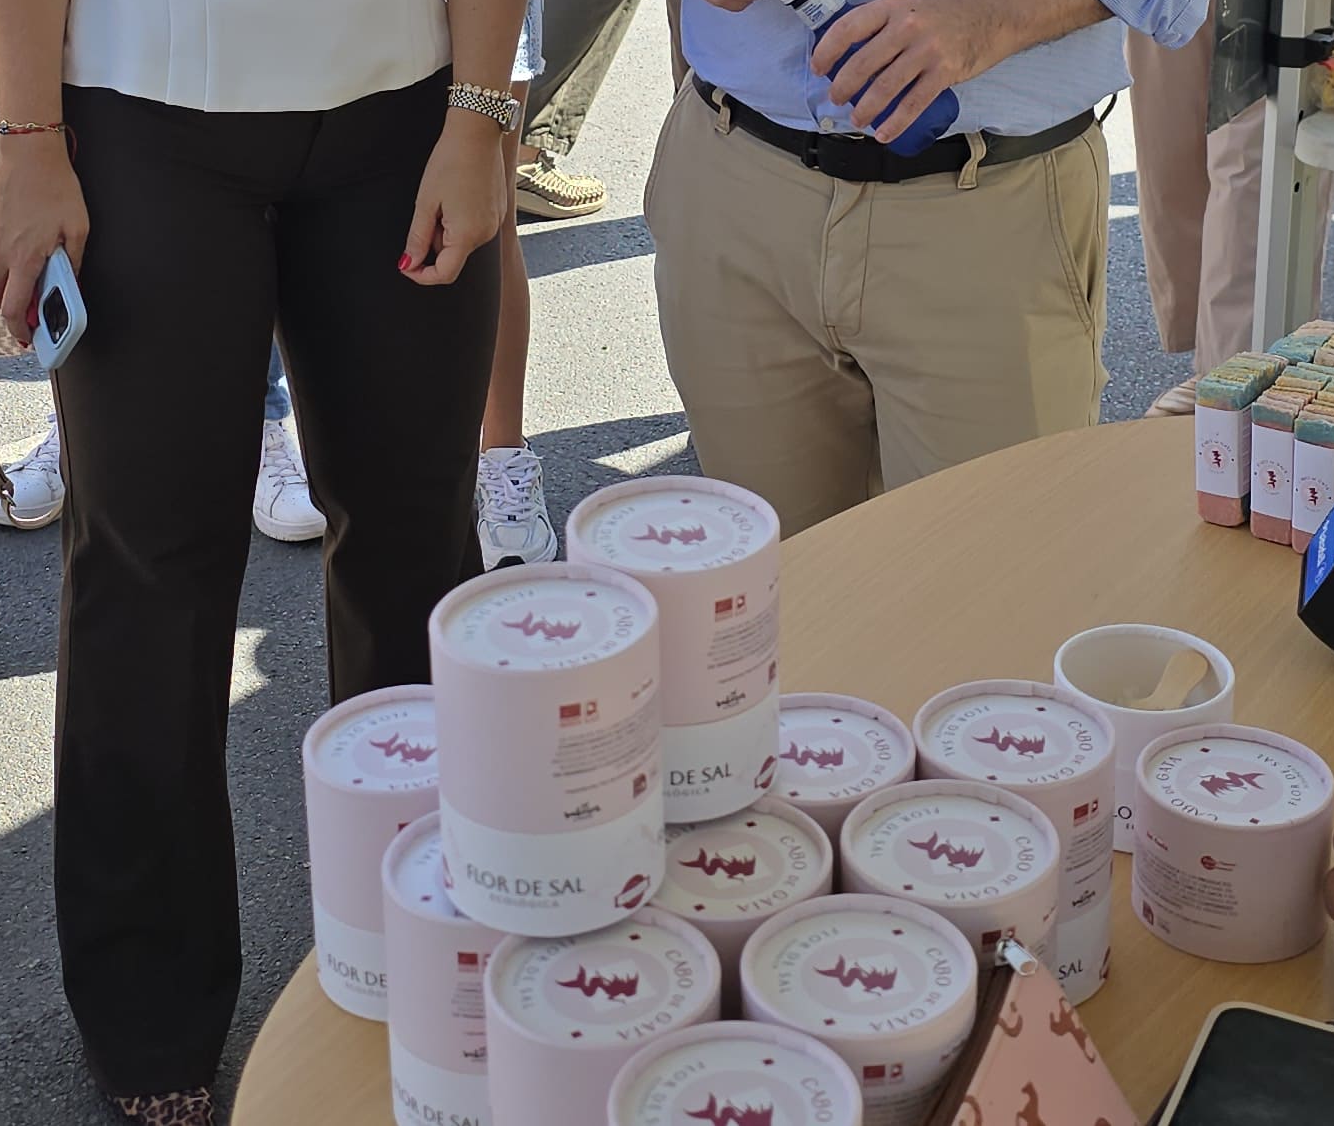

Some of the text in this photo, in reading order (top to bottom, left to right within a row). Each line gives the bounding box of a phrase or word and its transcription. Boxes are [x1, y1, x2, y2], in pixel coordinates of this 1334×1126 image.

[1068, 721, 1094, 753] CABO
[670, 762, 733, 787] DE SAL
[1155, 755, 1183, 782] GATA
[1288, 783, 1303, 807] FLOR
[1015, 835, 1036, 872] CABO
[467, 862, 586, 897] FLOR DE SAL
[327, 952, 360, 983] FLOR
[365, 970, 387, 990] DE
[666, 949, 694, 989] CABO
[925, 947, 953, 987] CABO
[1057, 959, 1084, 980] SAL
